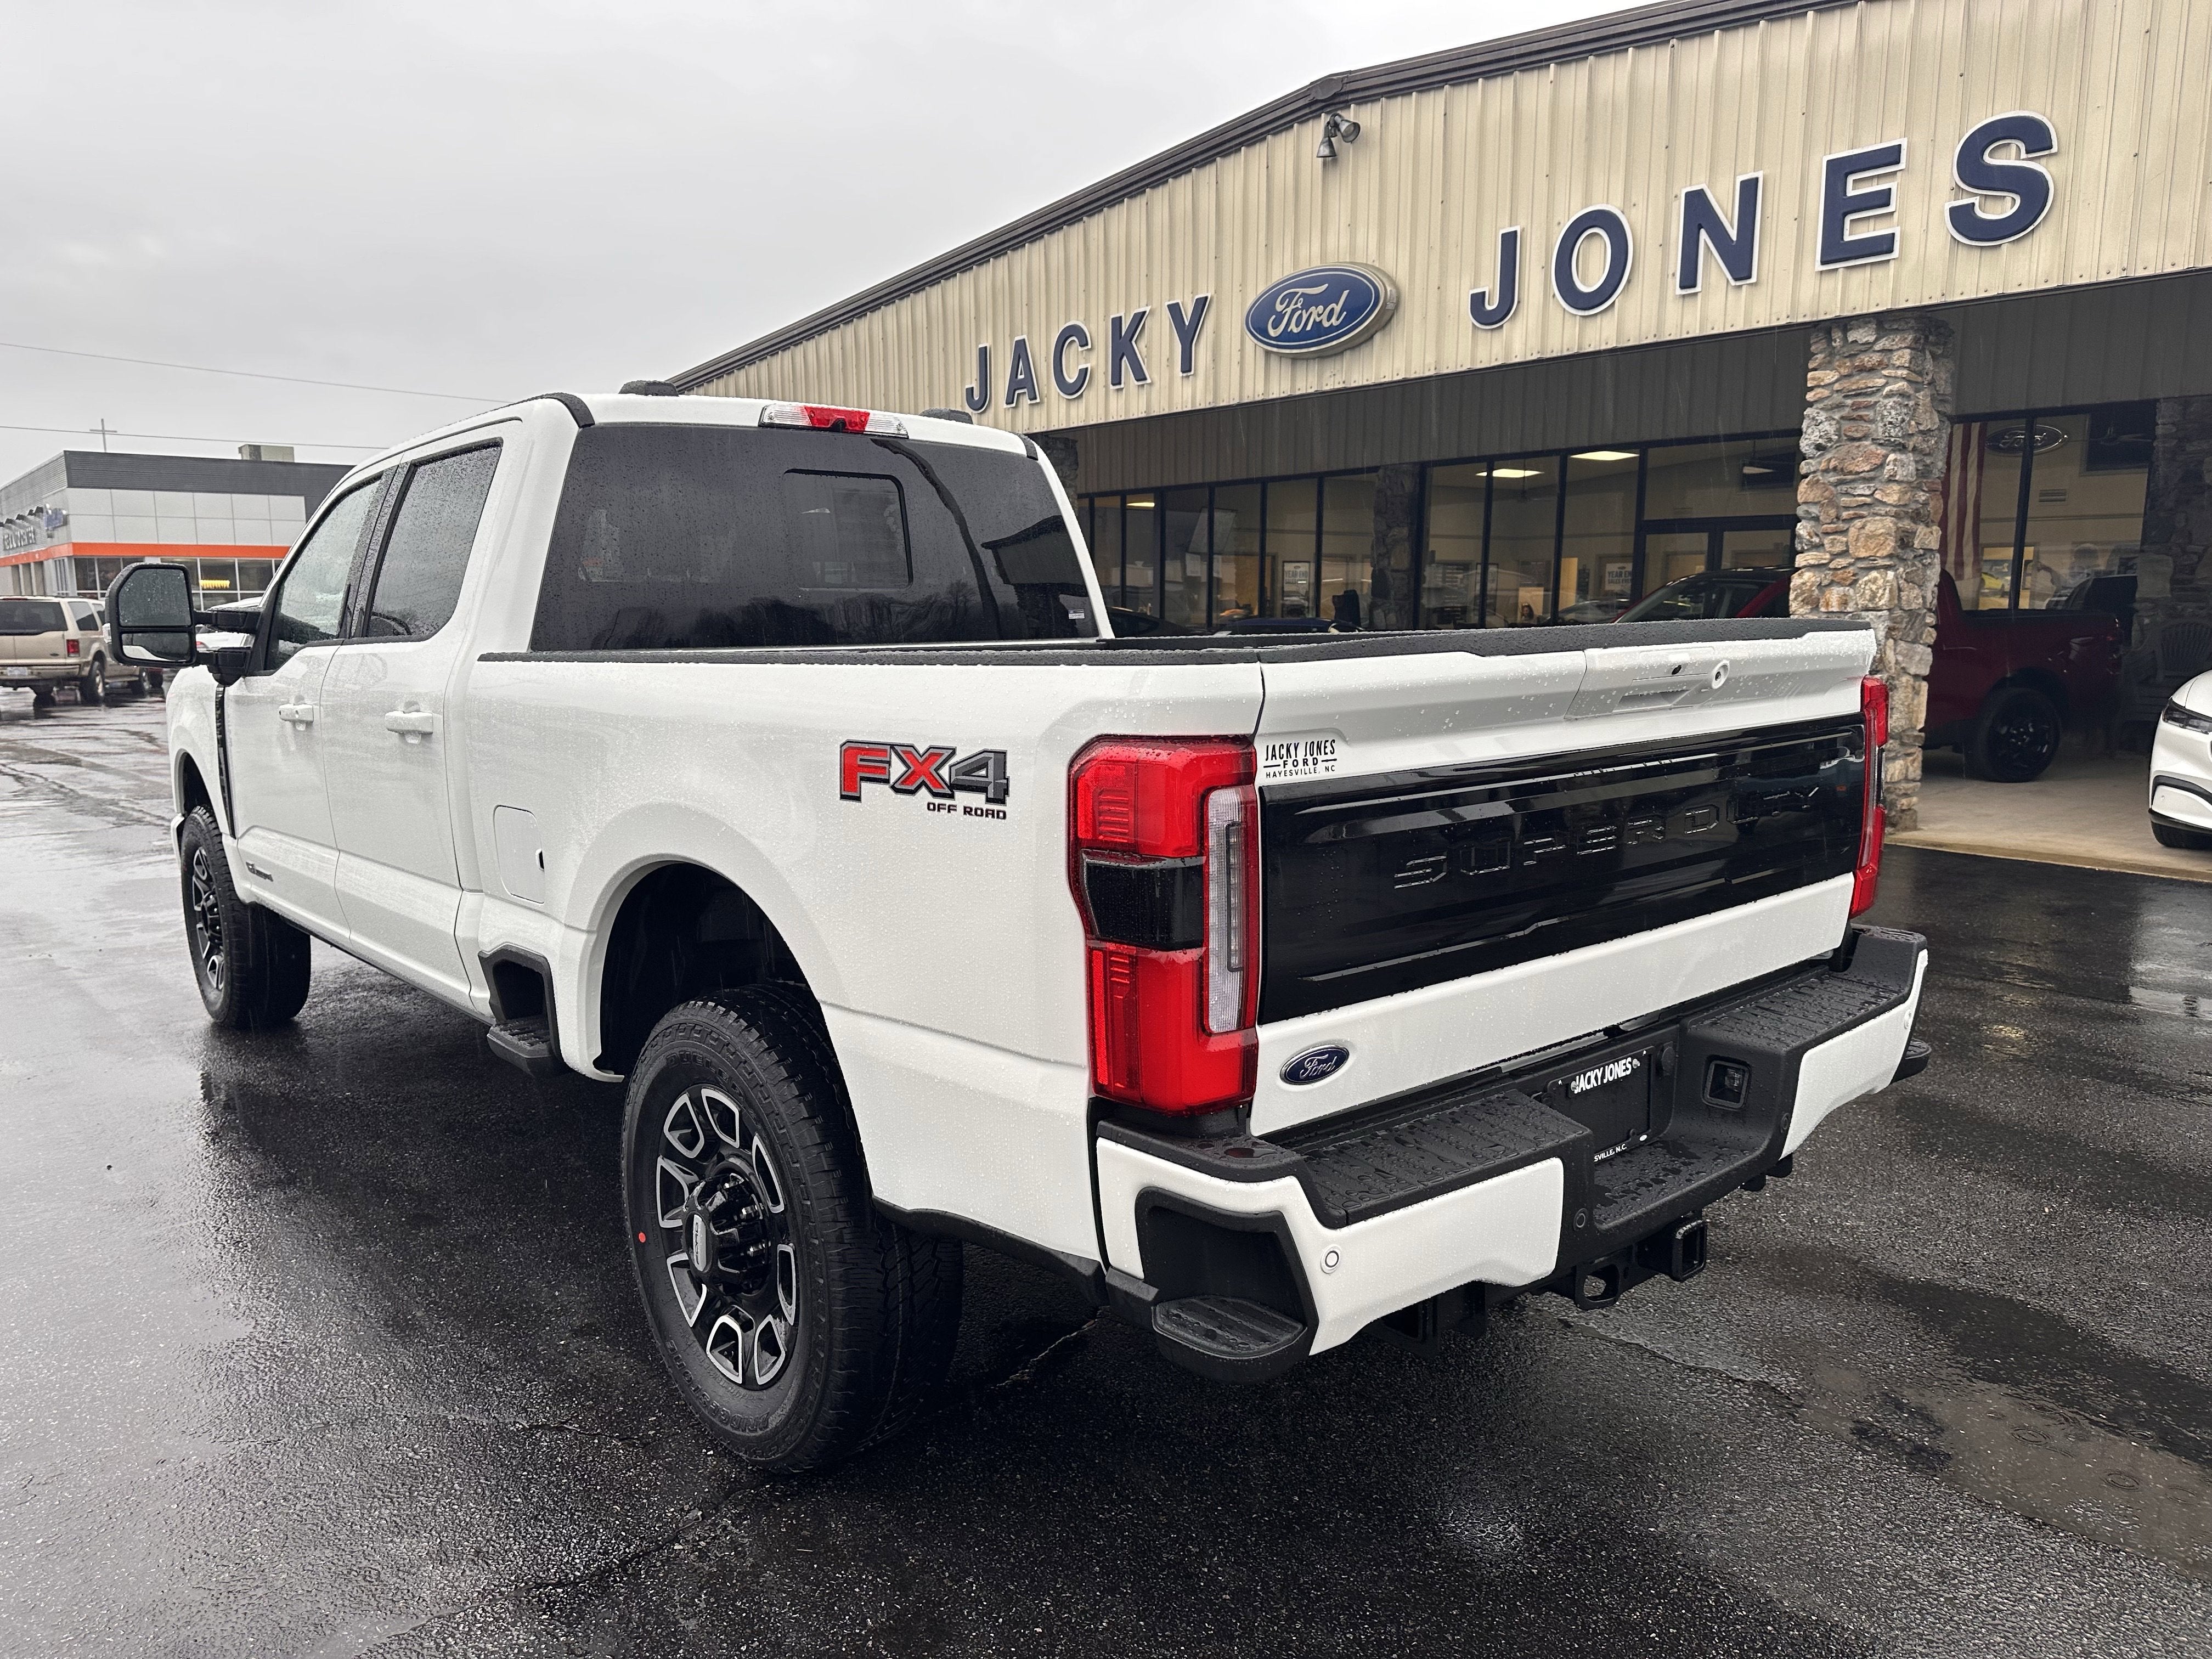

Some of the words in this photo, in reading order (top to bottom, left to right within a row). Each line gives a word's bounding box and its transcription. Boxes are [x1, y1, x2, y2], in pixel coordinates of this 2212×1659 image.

[966, 293, 1210, 414] JACKY
[1267, 283, 1350, 337] Ford
[1469, 110, 2058, 329] JONES
[1266, 742, 1300, 761] JACKY
[1304, 740, 1336, 757] JONES
[1283, 757, 1318, 769] FORD
[840, 739, 1010, 806] FX4
[1266, 767, 1321, 778] HAYESVILLE,
[927, 802, 957, 814] OFF
[963, 805, 1007, 820] ROAD
[1393, 815, 1668, 889] SUPER
[1299, 1054, 1338, 1079] Ford
[1574, 1066, 1603, 1093] JACKY
[1604, 1057, 1632, 1084] JONES
[1594, 1148, 1615, 1163] SVILLE,
[1616, 1143, 1627, 1153] N.C.
[665, 1340, 771, 1434] BRIDGESTONE
